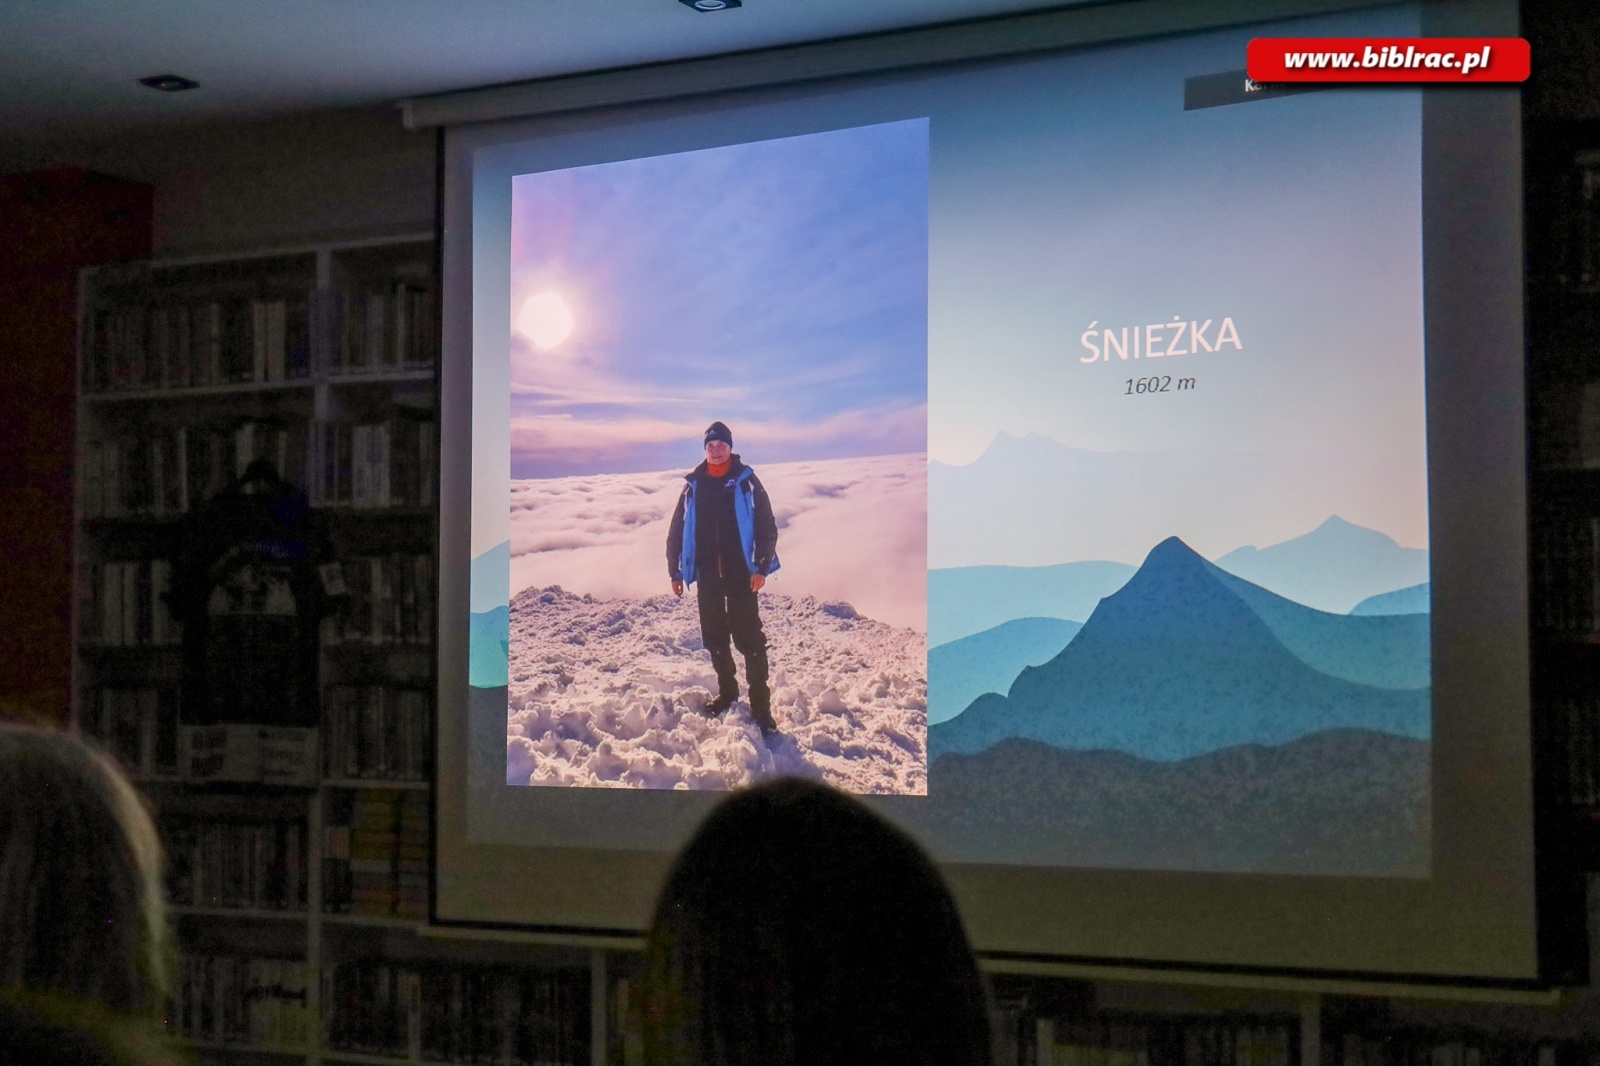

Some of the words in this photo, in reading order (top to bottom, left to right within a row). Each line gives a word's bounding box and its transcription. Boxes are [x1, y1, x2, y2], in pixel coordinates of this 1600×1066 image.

[1080, 315, 1243, 364] ŚNIEŻKA
[1124, 375, 1171, 395] 1602
[1177, 377, 1195, 391] m
